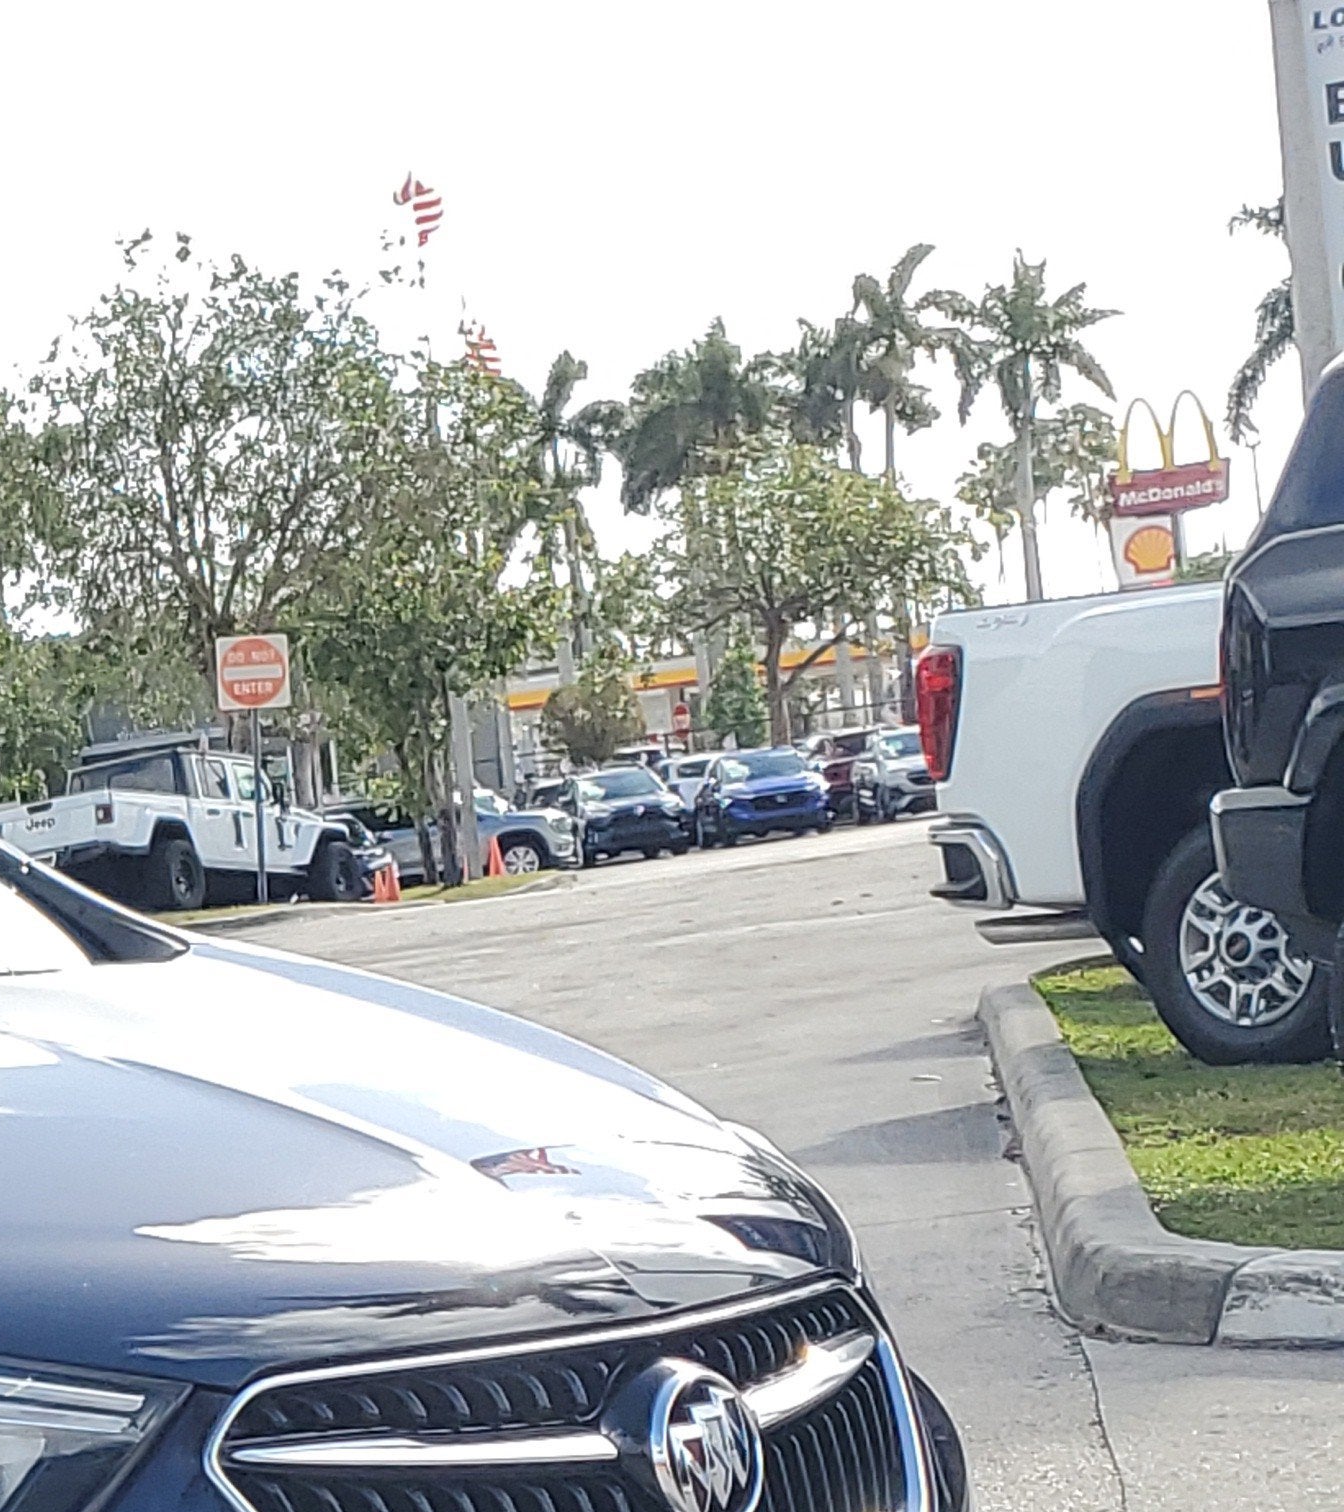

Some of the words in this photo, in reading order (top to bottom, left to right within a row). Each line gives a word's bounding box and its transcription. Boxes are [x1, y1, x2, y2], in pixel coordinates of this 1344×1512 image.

[1118, 479, 1224, 507] McDonald's
[226, 651, 245, 663] DO
[251, 648, 275, 661] NOT
[233, 681, 273, 696] ENTER
[25, 818, 56, 831] Jeep
